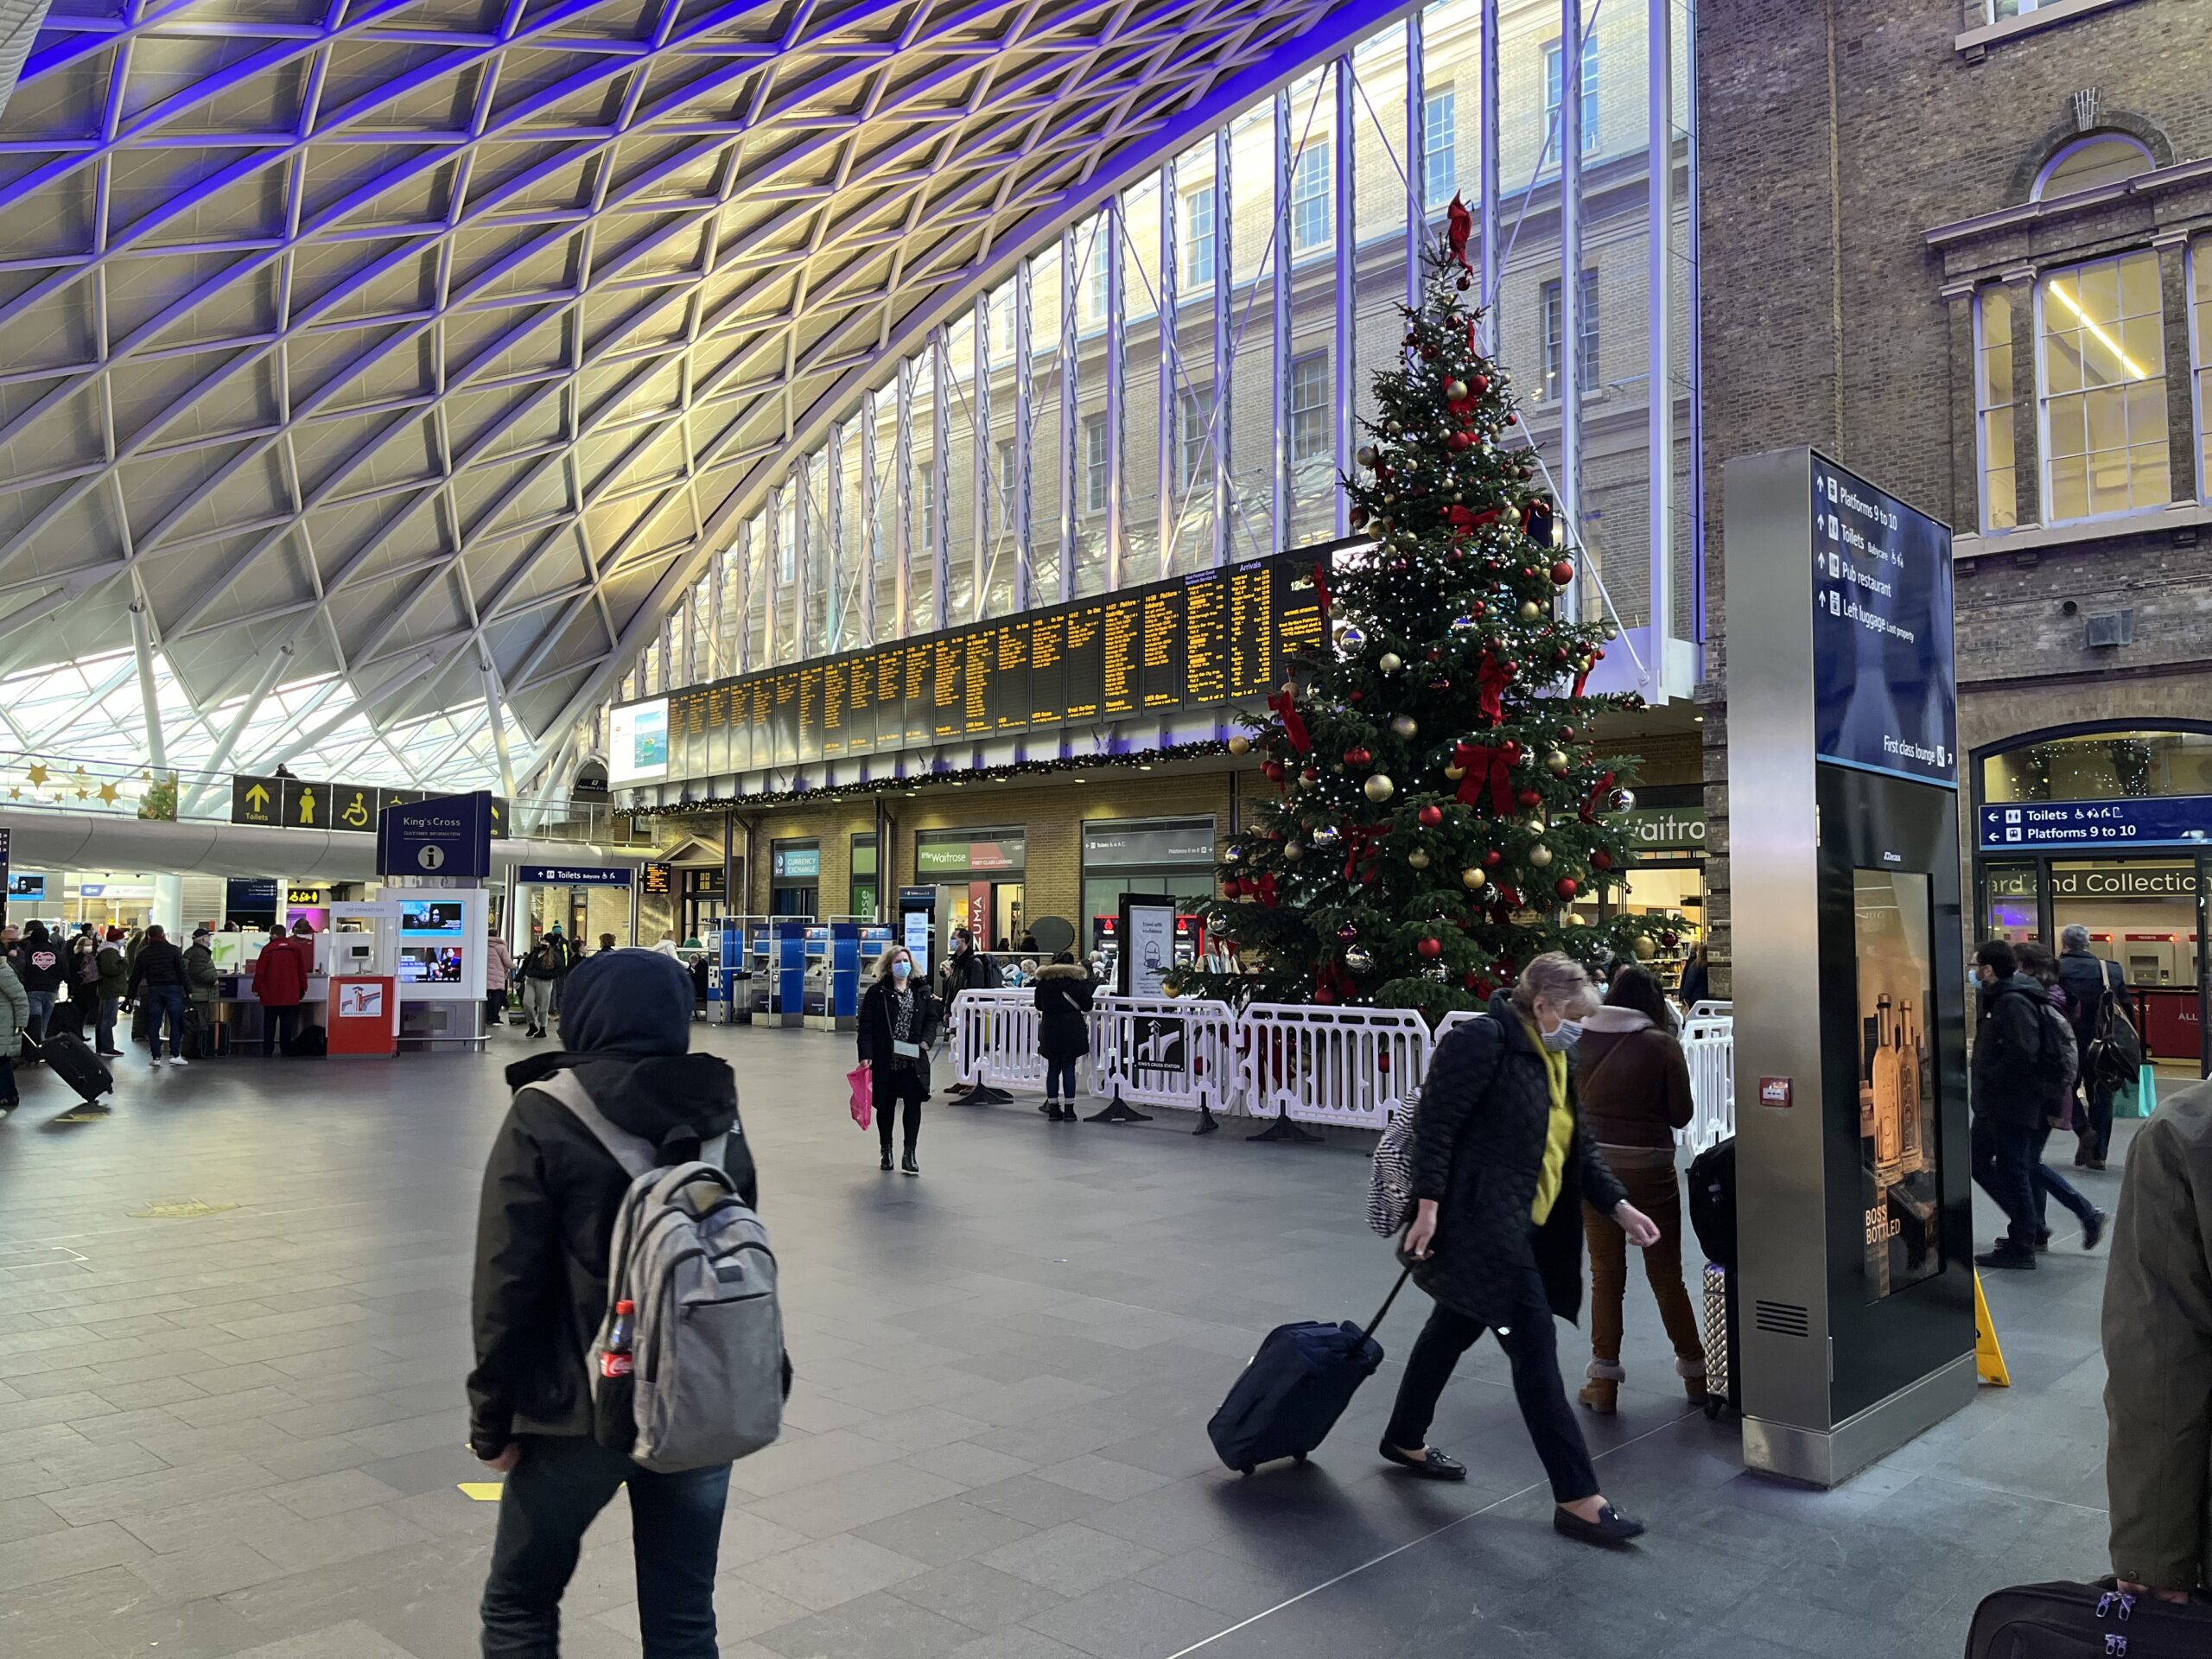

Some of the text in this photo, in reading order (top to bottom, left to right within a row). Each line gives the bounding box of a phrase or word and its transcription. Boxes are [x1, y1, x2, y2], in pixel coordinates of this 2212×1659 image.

[1840, 487, 1897, 531] Platforms 9 to 10
[1841, 524, 1888, 562] Toilets Babycare
[1240, 562, 1262, 572] Arrivals
[1842, 562, 1891, 598] Pub restaurant
[1844, 599, 1885, 632] Left luggage
[1887, 621, 1914, 643] Lost property
[1884, 734, 1936, 766] First class lounge
[245, 812, 268, 821] Toilets
[403, 817, 461, 828] King's Cross
[2027, 810, 2068, 821] Toilets
[2027, 825, 2136, 840] Platforms 9 to 10
[788, 857, 816, 866] CURRENCY
[931, 852, 966, 863] Waitrose
[557, 871, 581, 880] Toilets
[1866, 1205, 1887, 1227] BOSS
[1866, 1218, 1901, 1244] BOTTLED
